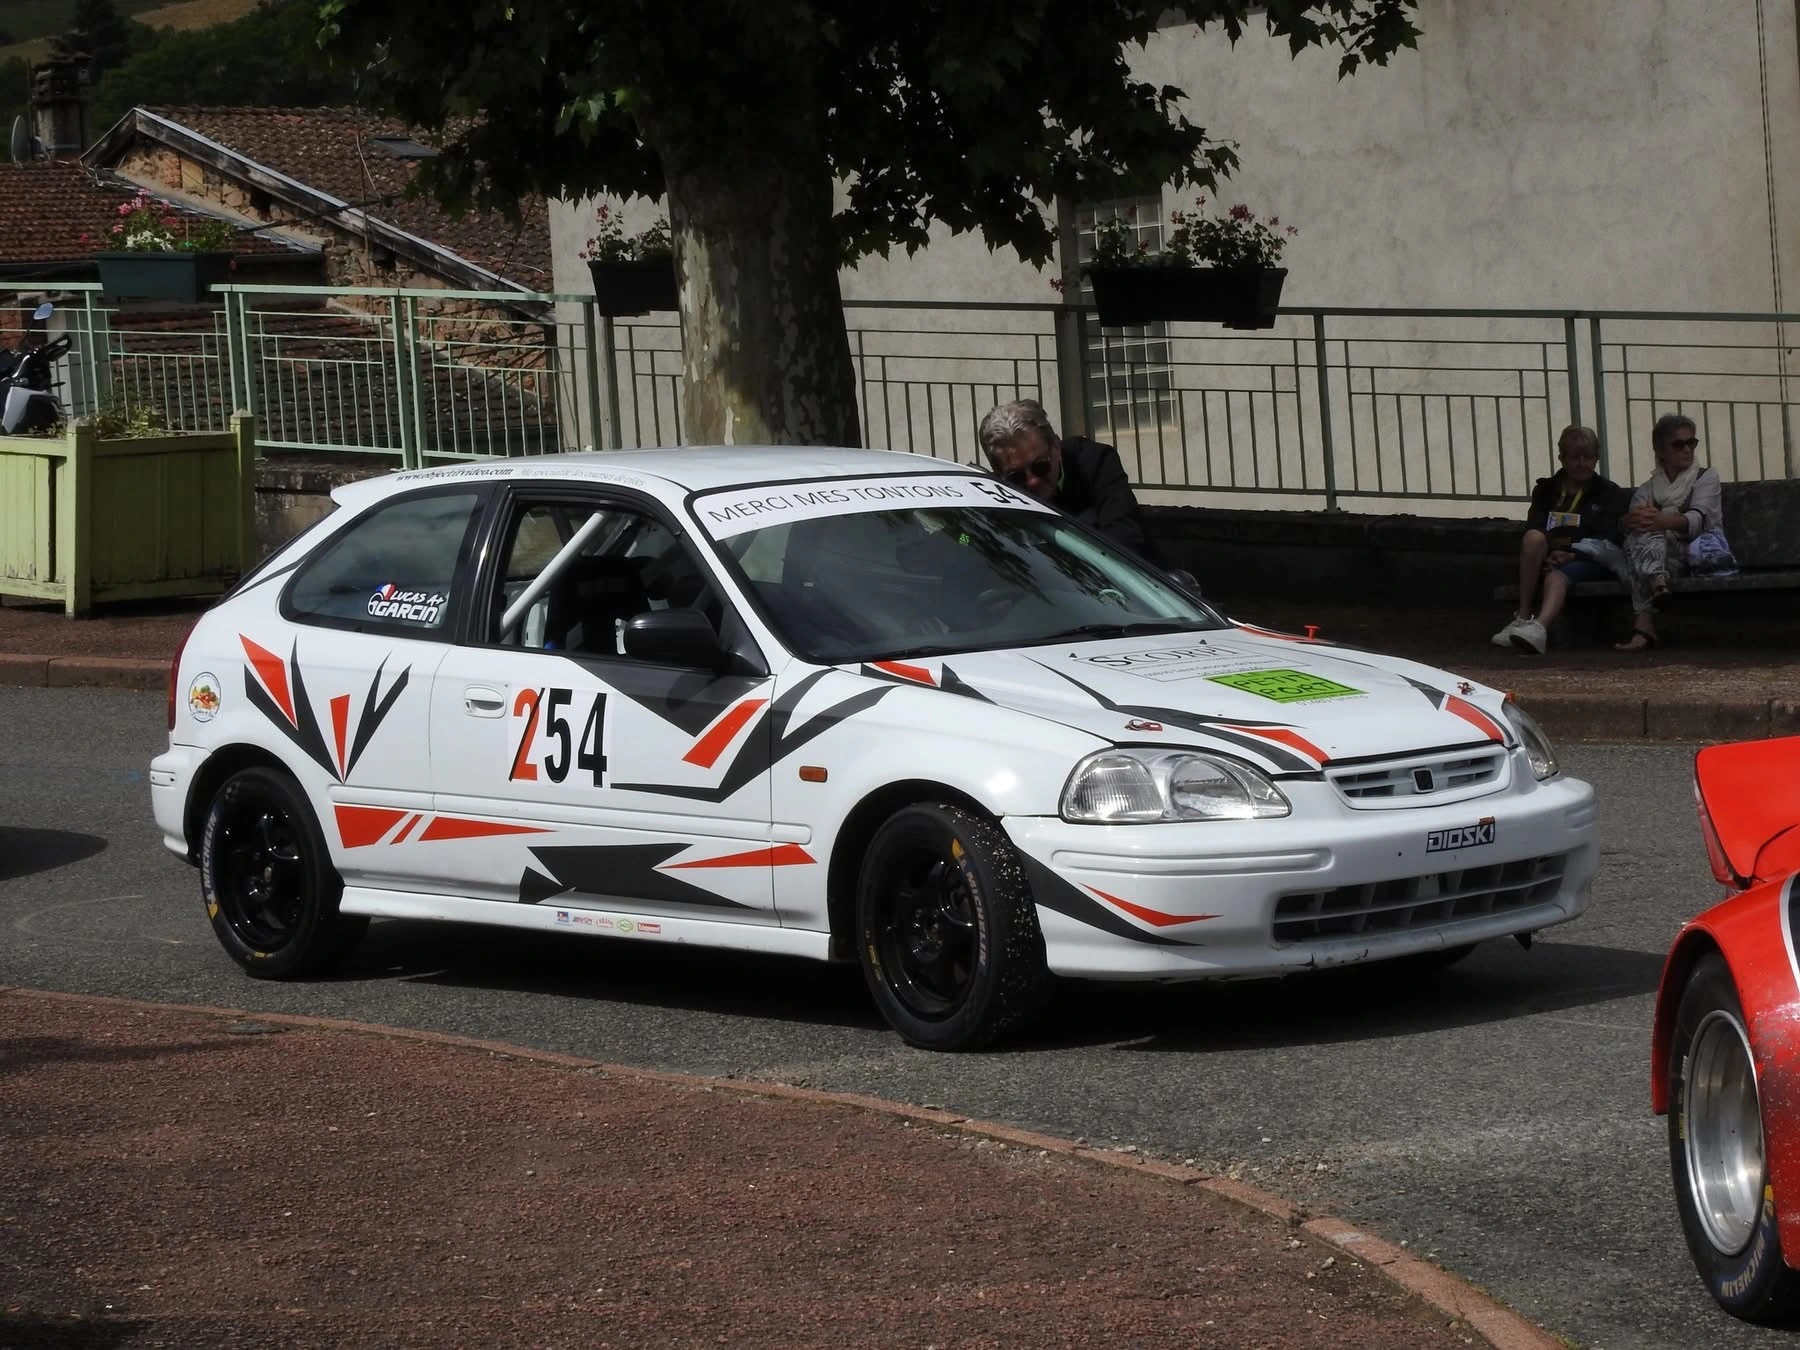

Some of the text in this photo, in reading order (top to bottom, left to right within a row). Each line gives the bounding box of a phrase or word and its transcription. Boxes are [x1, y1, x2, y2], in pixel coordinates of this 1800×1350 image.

[708, 481, 1031, 523] MERCI MES TONTONS 54
[390, 590, 427, 604] LUCAS
[374, 601, 439, 622] GARCIN
[1233, 673, 1312, 689] PETIT
